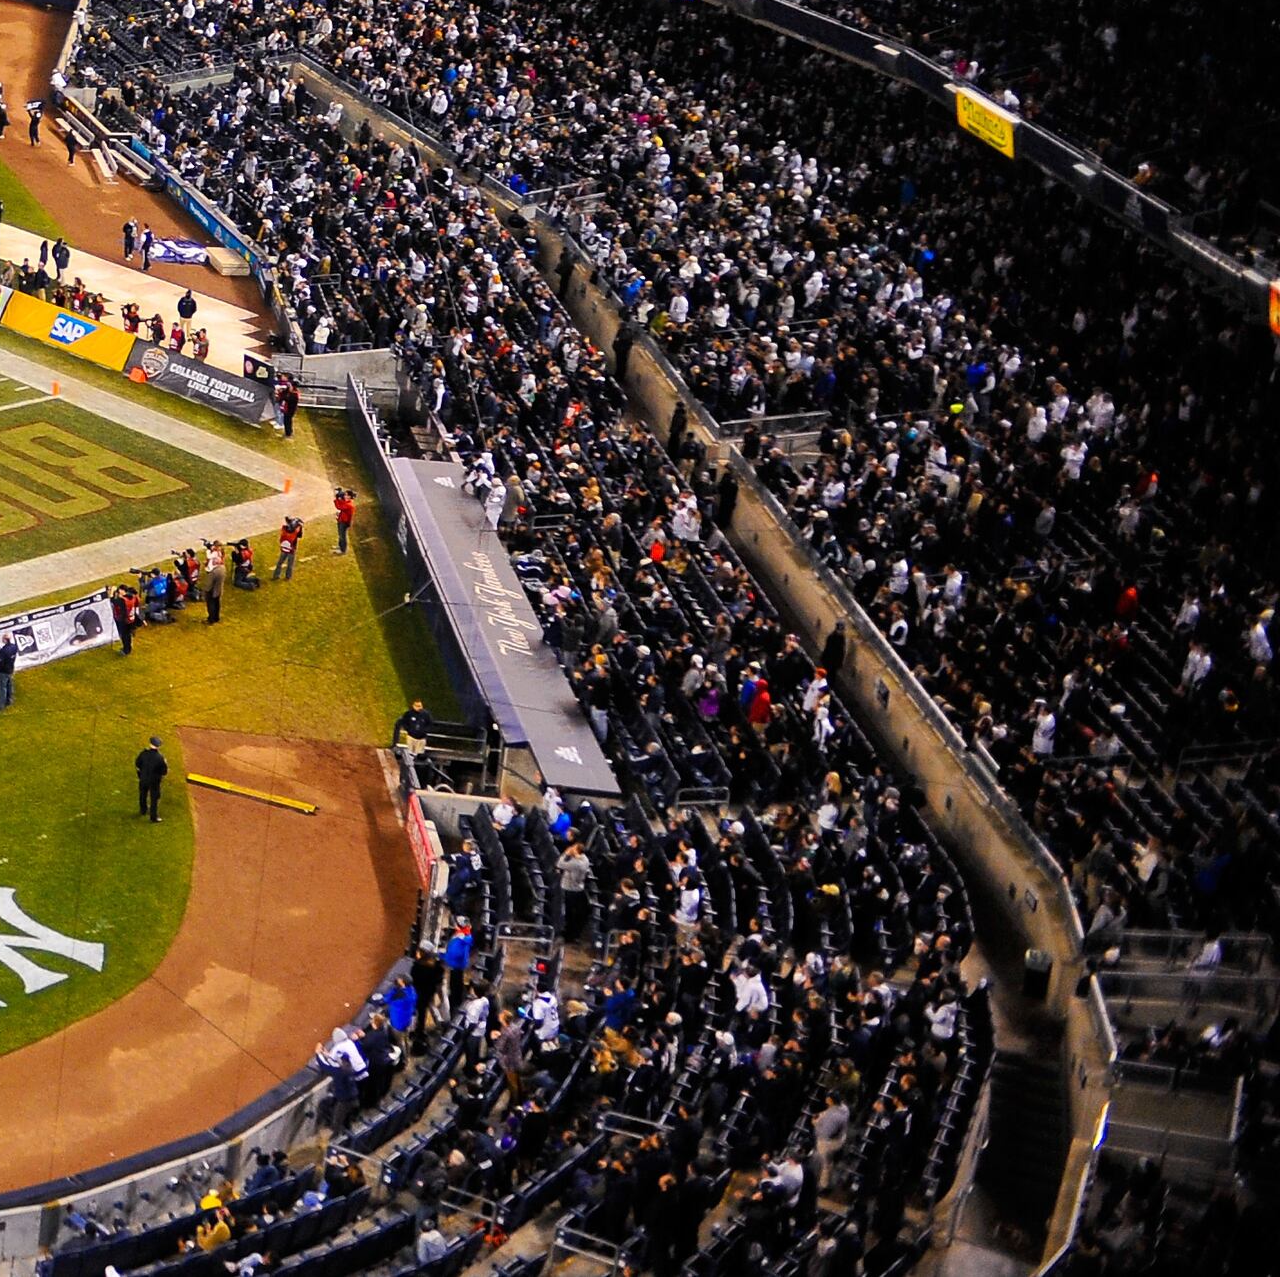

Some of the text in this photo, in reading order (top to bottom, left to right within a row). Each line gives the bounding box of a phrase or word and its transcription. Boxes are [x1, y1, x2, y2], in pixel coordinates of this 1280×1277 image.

[50, 317, 86, 342] SAP
[169, 362, 256, 404] COLLEGE FOOTBALL
[187, 378, 209, 394] LIVES
[463, 550, 539, 657] New York Yankees
